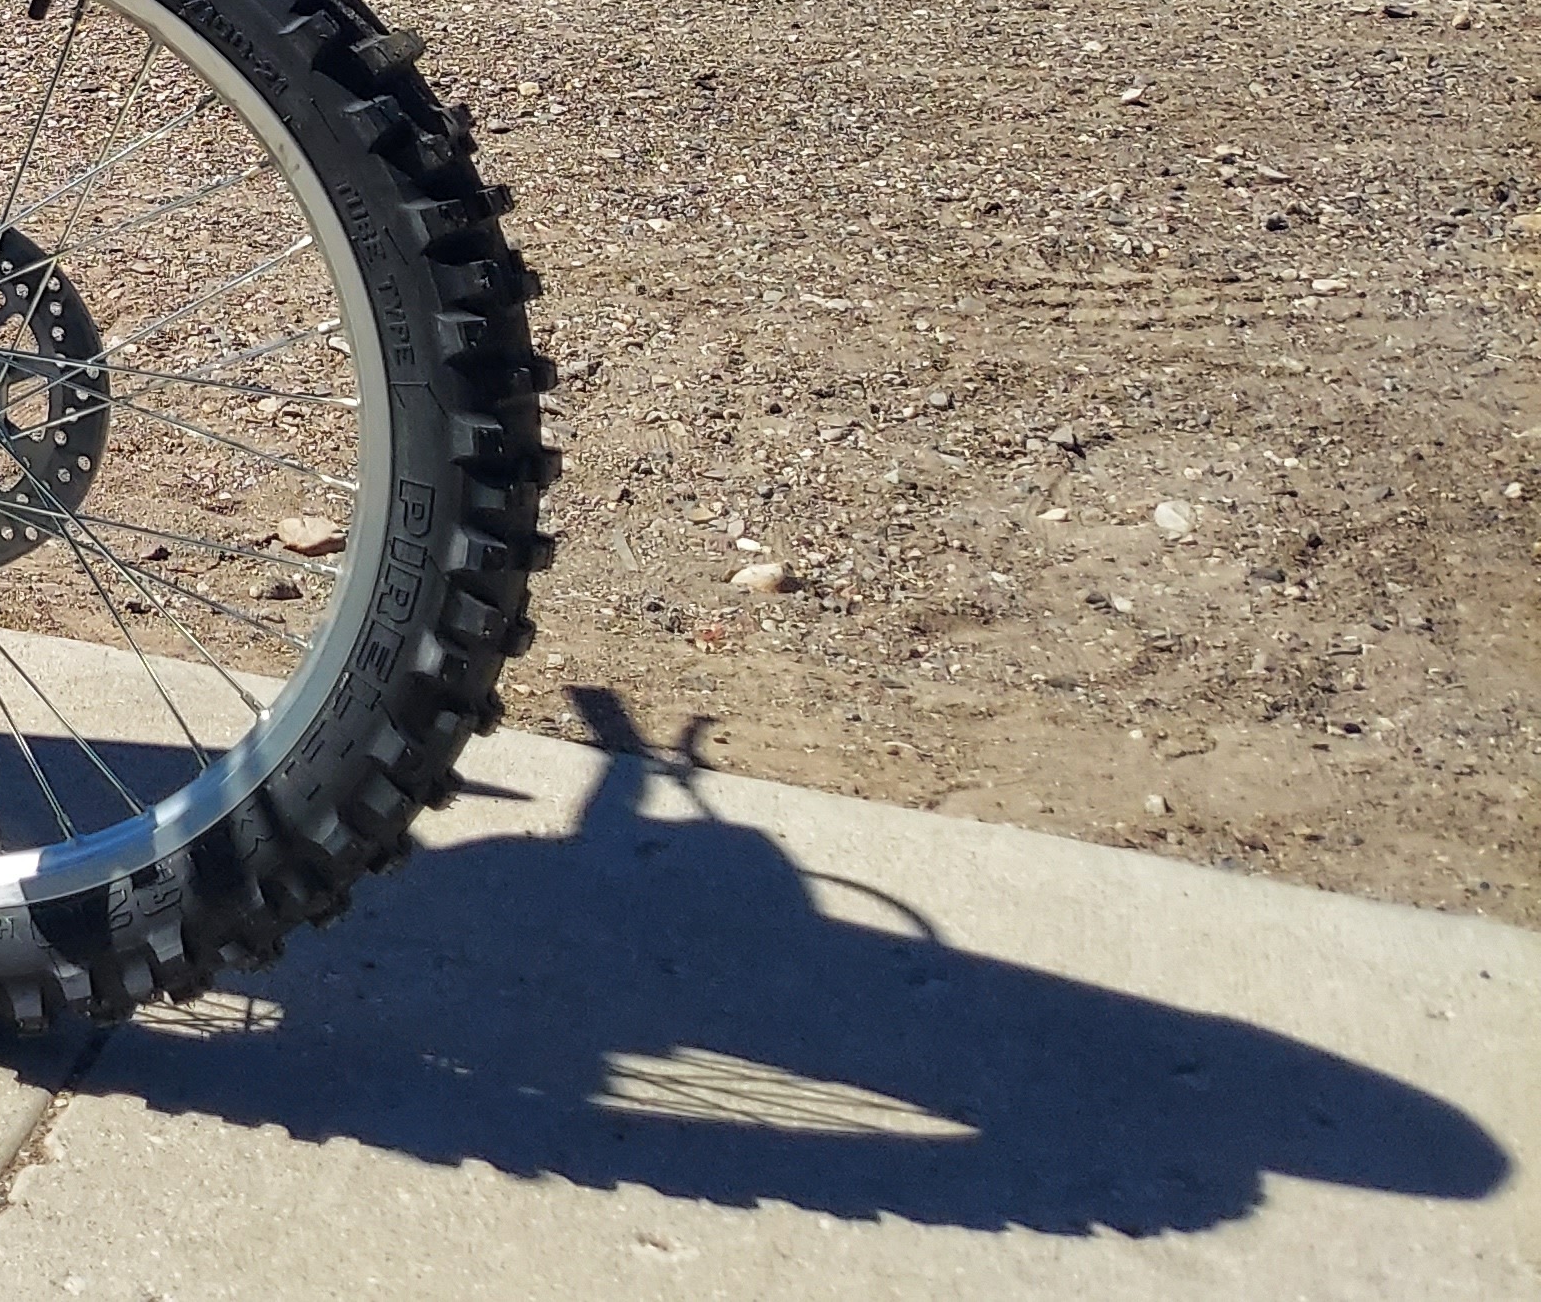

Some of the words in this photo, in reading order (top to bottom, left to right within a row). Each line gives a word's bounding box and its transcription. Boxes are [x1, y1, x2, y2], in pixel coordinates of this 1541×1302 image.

[335, 179, 386, 263] TUBE
[376, 273, 416, 366] TYPE
[282, 477, 436, 800] PIRELLI
